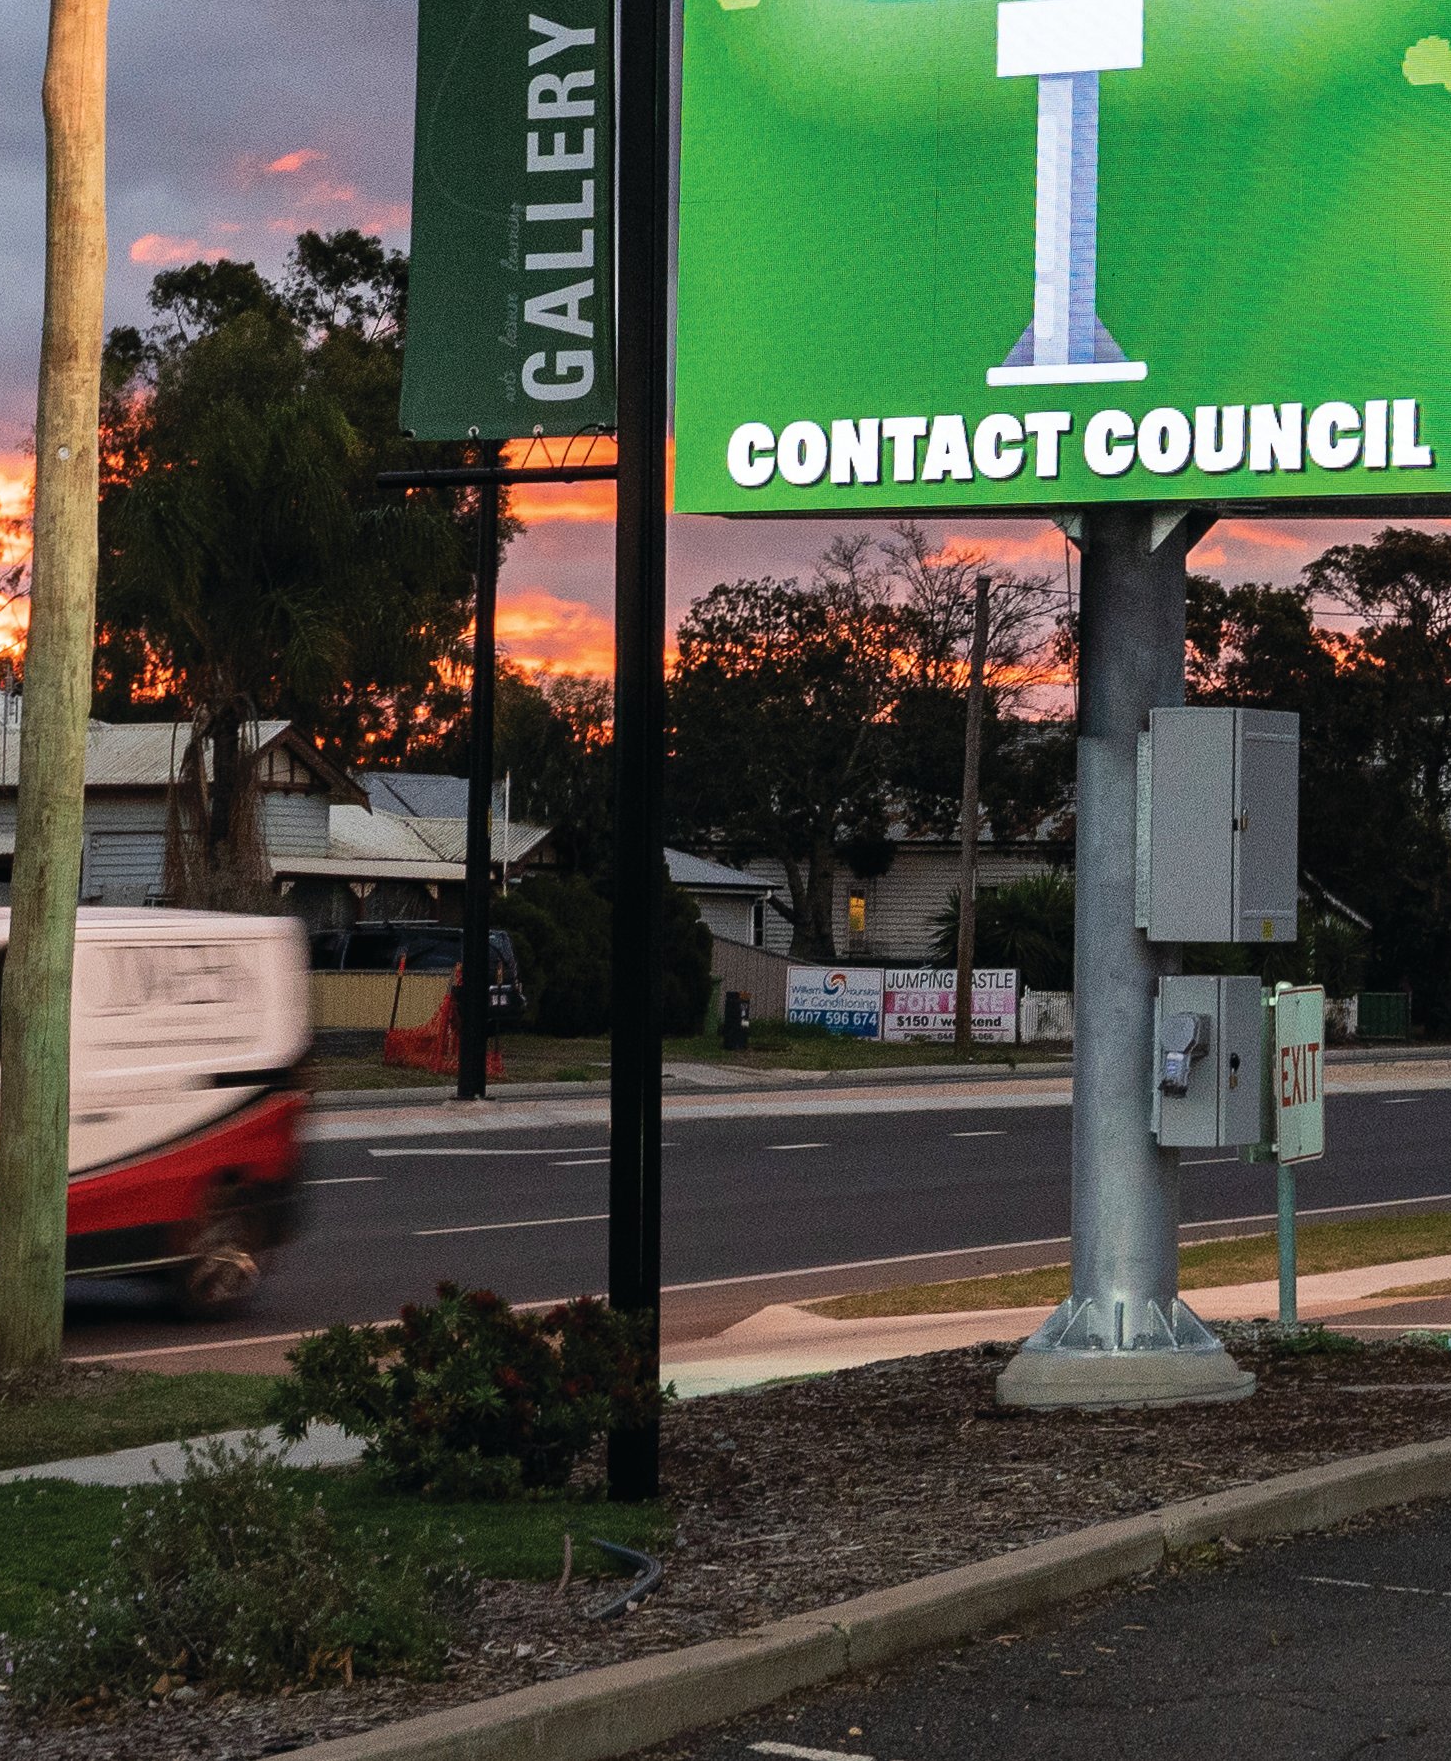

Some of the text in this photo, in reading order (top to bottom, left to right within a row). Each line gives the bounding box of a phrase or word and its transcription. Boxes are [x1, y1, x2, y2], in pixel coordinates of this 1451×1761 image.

[521, 13, 596, 402] GALLERY
[726, 398, 1435, 489] CONTACT COUNCIL
[887, 972, 1014, 989] JUMPING ASTLE
[894, 993, 1005, 1012] FOR HRE
[789, 1010, 877, 1026] 0407 596 674
[896, 1015, 929, 1027] $150
[940, 1016, 1002, 1027] wekend
[1281, 1042, 1319, 1108] EXIT
